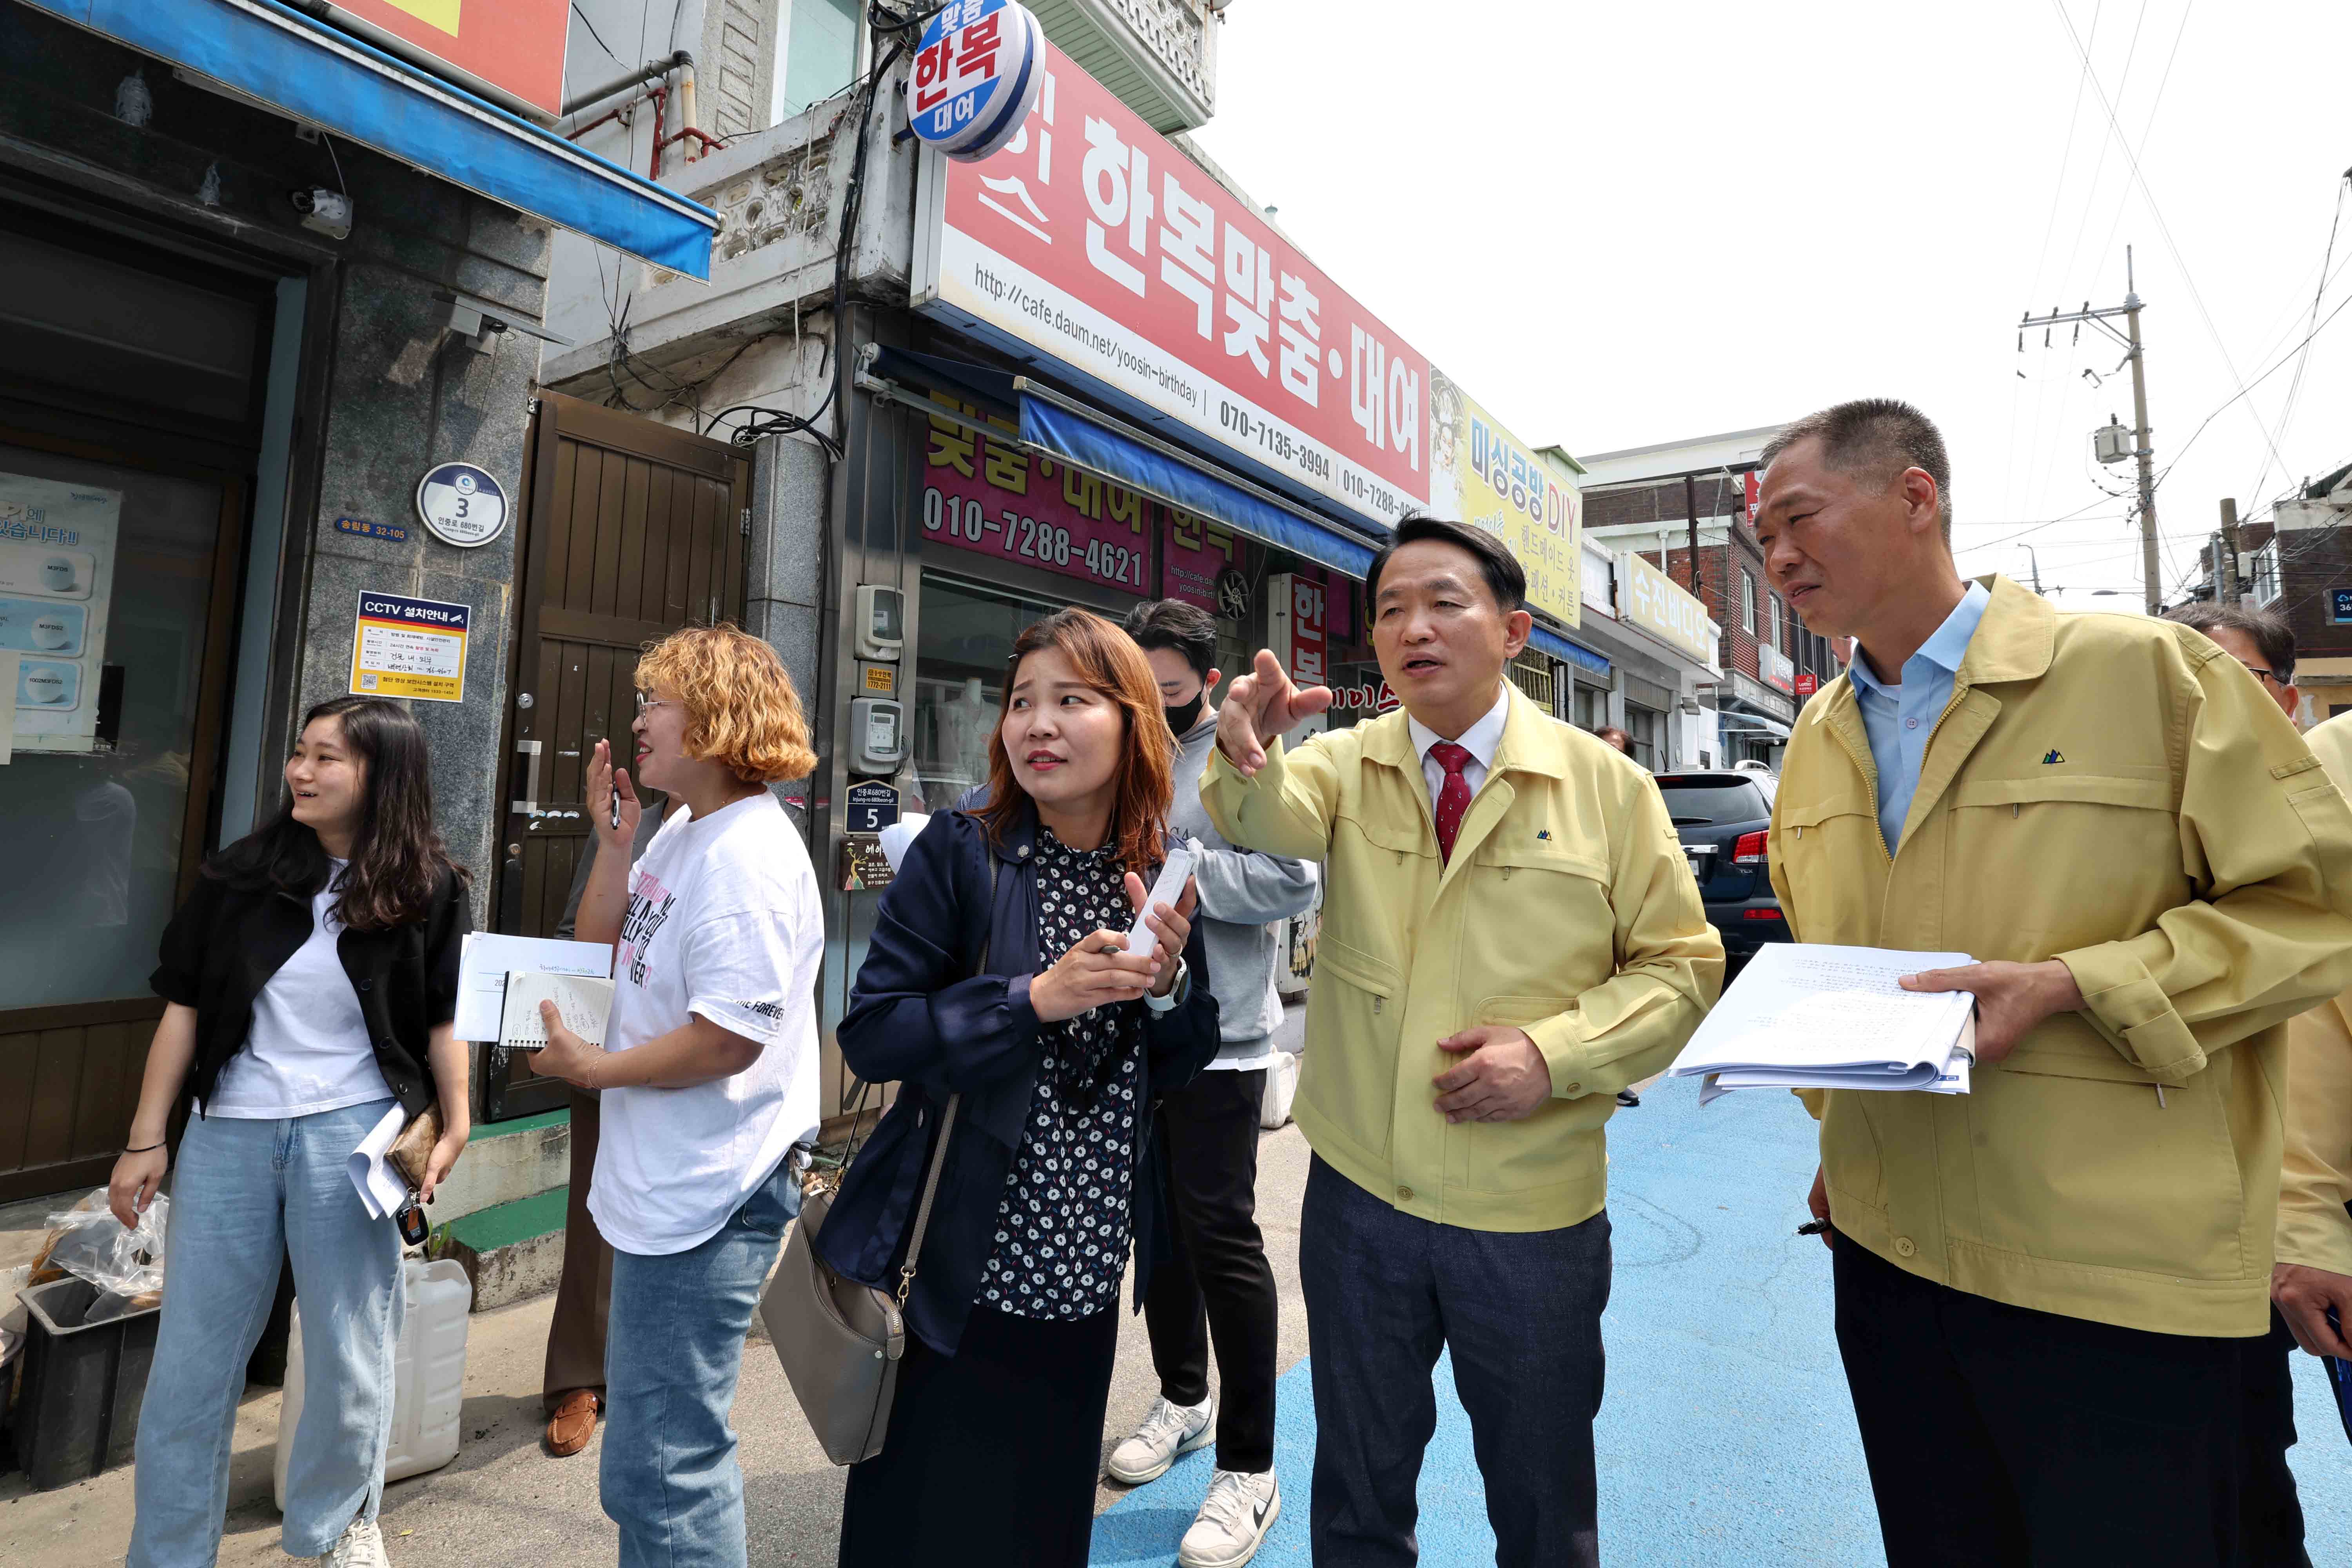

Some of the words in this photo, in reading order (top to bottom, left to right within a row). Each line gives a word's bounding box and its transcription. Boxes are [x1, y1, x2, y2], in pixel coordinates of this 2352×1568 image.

[941, 0, 984, 37] 맞춤
[916, 11, 1001, 112] 한복
[934, 91, 975, 133] 대여
[975, 262, 1197, 408] http://cafe.daum.net/yoosin-birthday
[1220, 401, 1330, 481] 070-7135-3994
[1471, 414, 1544, 524] 미싱공방
[1547, 481, 1577, 548] DIY
[438, 517, 458, 527] 인중로
[461, 521, 484, 532] 680번길
[456, 497, 469, 519] 3
[341, 520, 371, 533] 송림동
[376, 526, 405, 539] 32-105
[923, 487, 1141, 587] 010-7288-4621
[1521, 524, 1564, 573] 핸드메이드
[365, 601, 401, 615] CCTV
[404, 606, 448, 622] 설치안내
[1635, 568, 1707, 652] 수진비디오
[867, 808, 878, 828] 5
[865, 843, 884, 858] 에이
